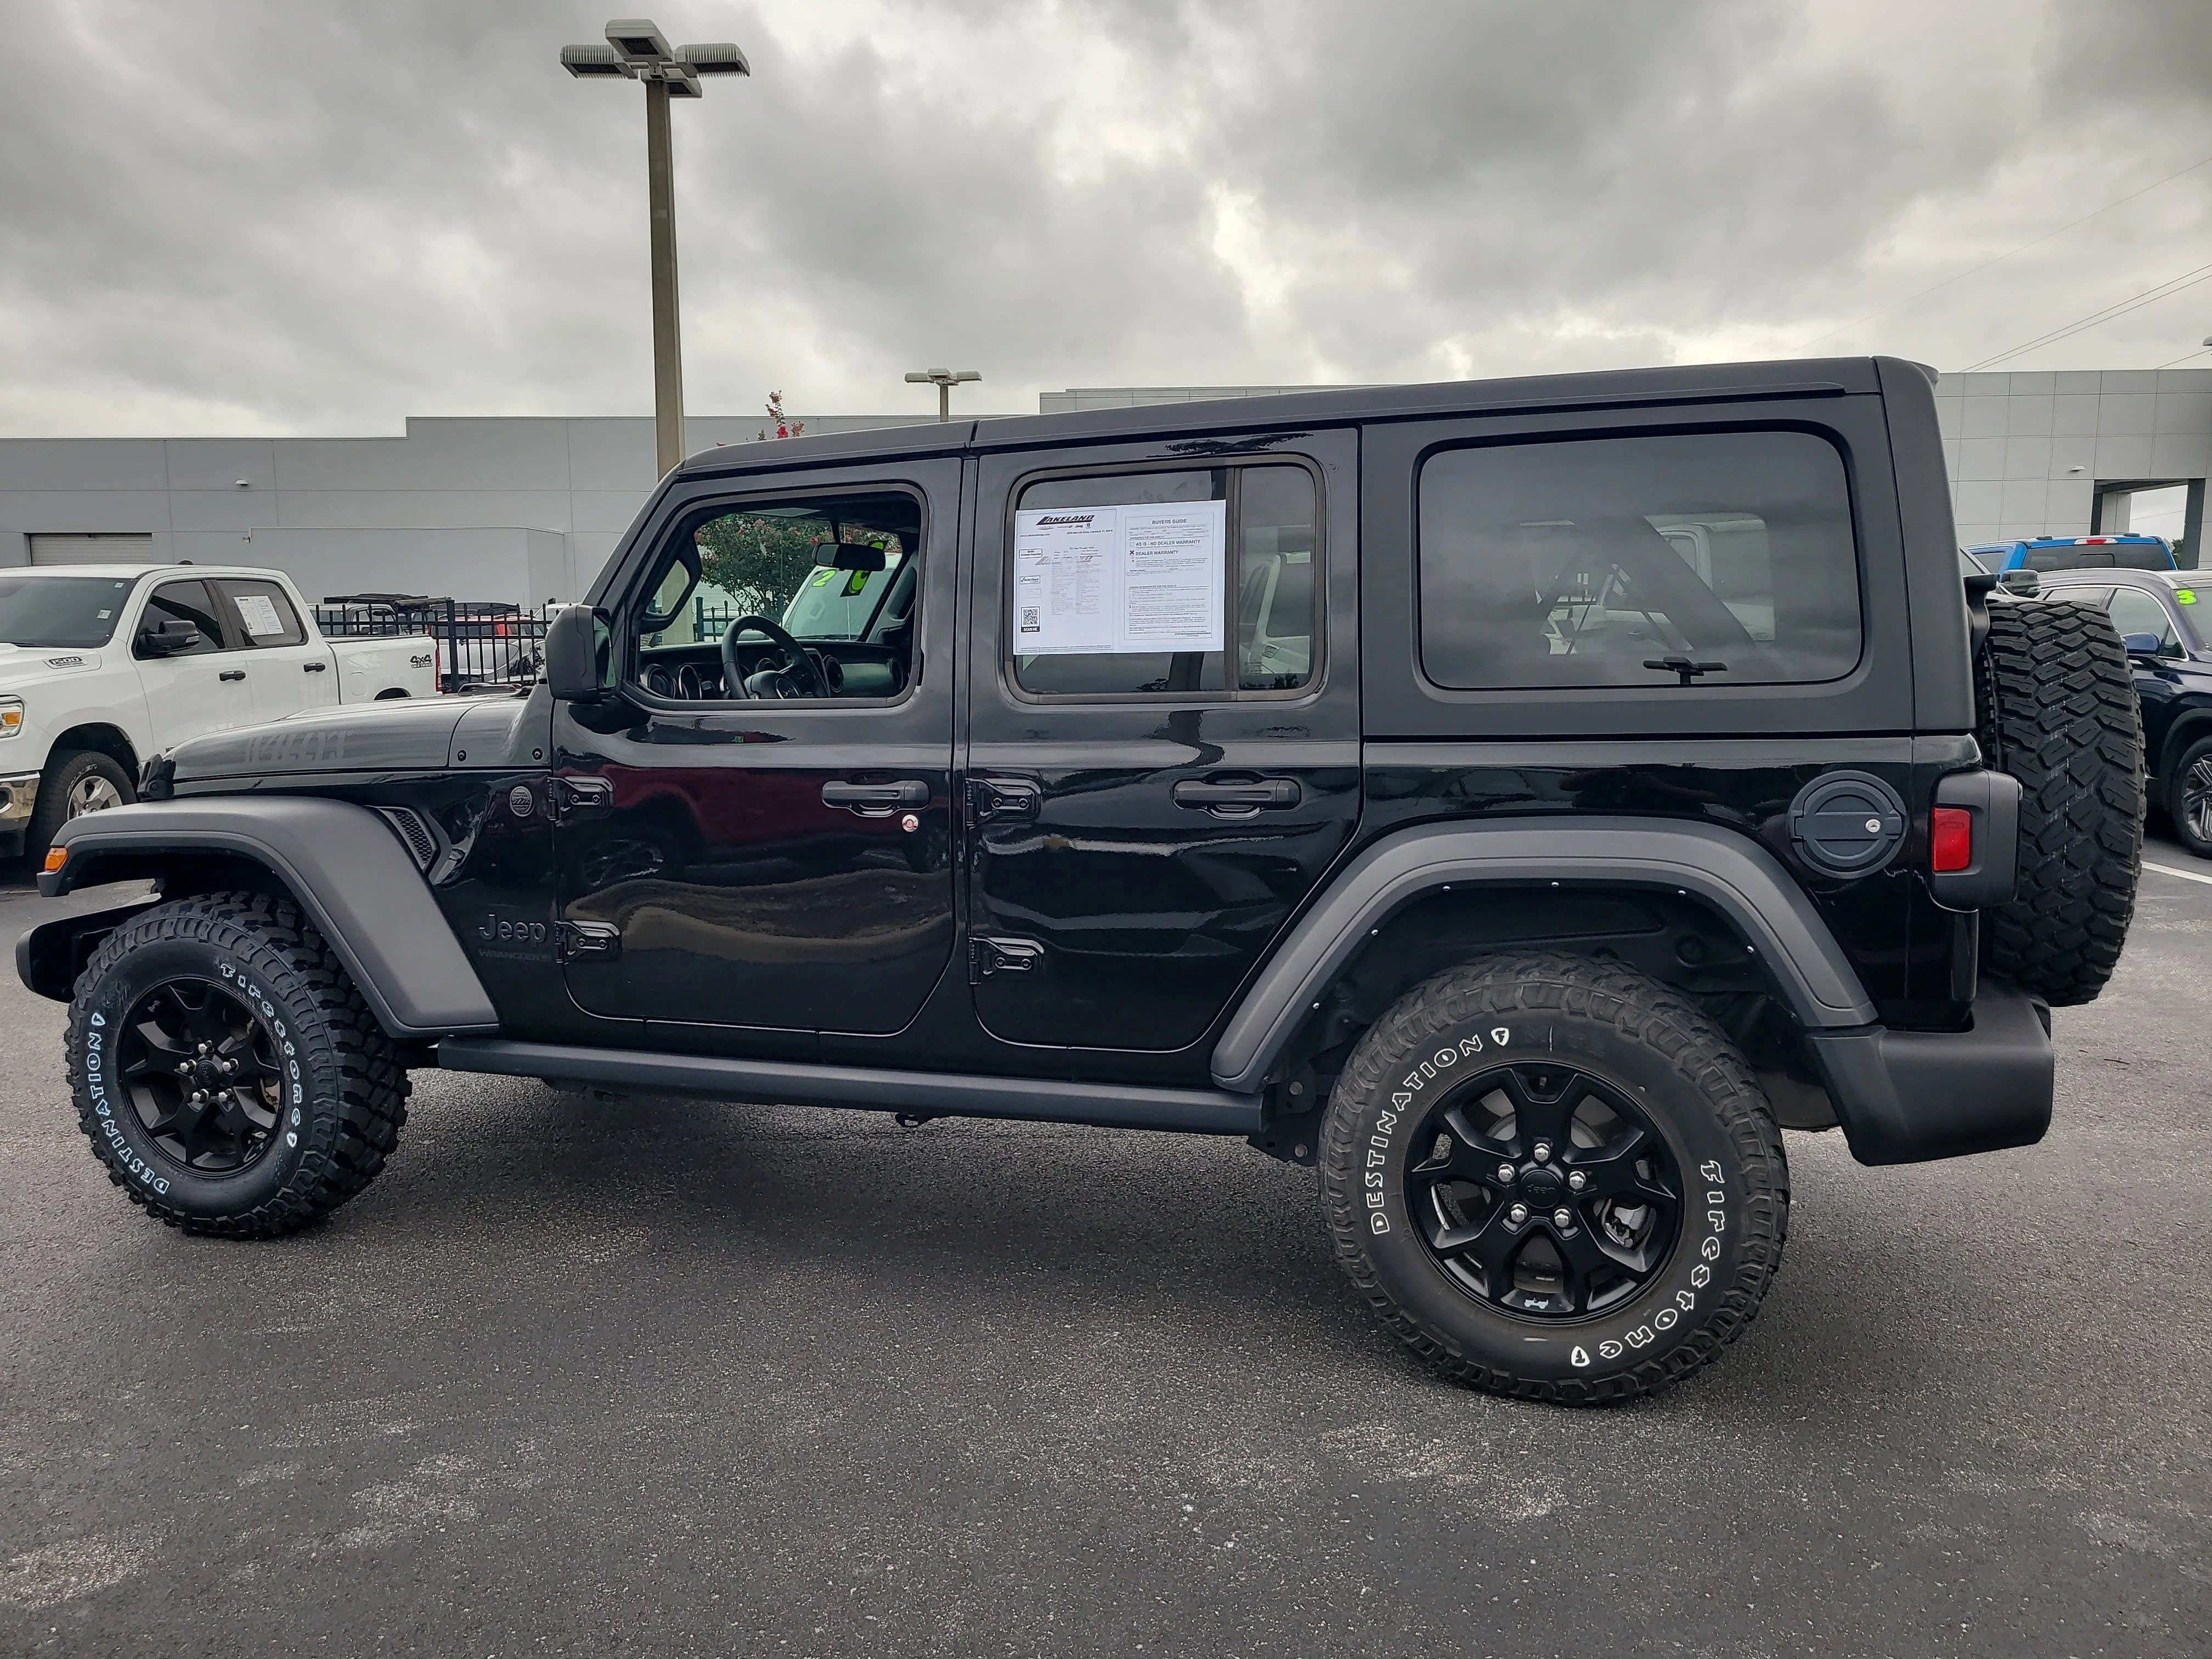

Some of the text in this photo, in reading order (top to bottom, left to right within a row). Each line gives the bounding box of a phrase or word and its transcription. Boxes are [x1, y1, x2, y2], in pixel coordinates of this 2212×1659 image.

[1036, 515, 1094, 526] LAKELAND
[410, 654, 432, 664] 4x4
[479, 914, 546, 946] Jeep
[86, 1032, 171, 1195] DESTINATION
[220, 963, 302, 1127] Firestone
[1365, 1034, 1483, 1234] DESTINATION
[1598, 1159, 1726, 1359] Firestone
